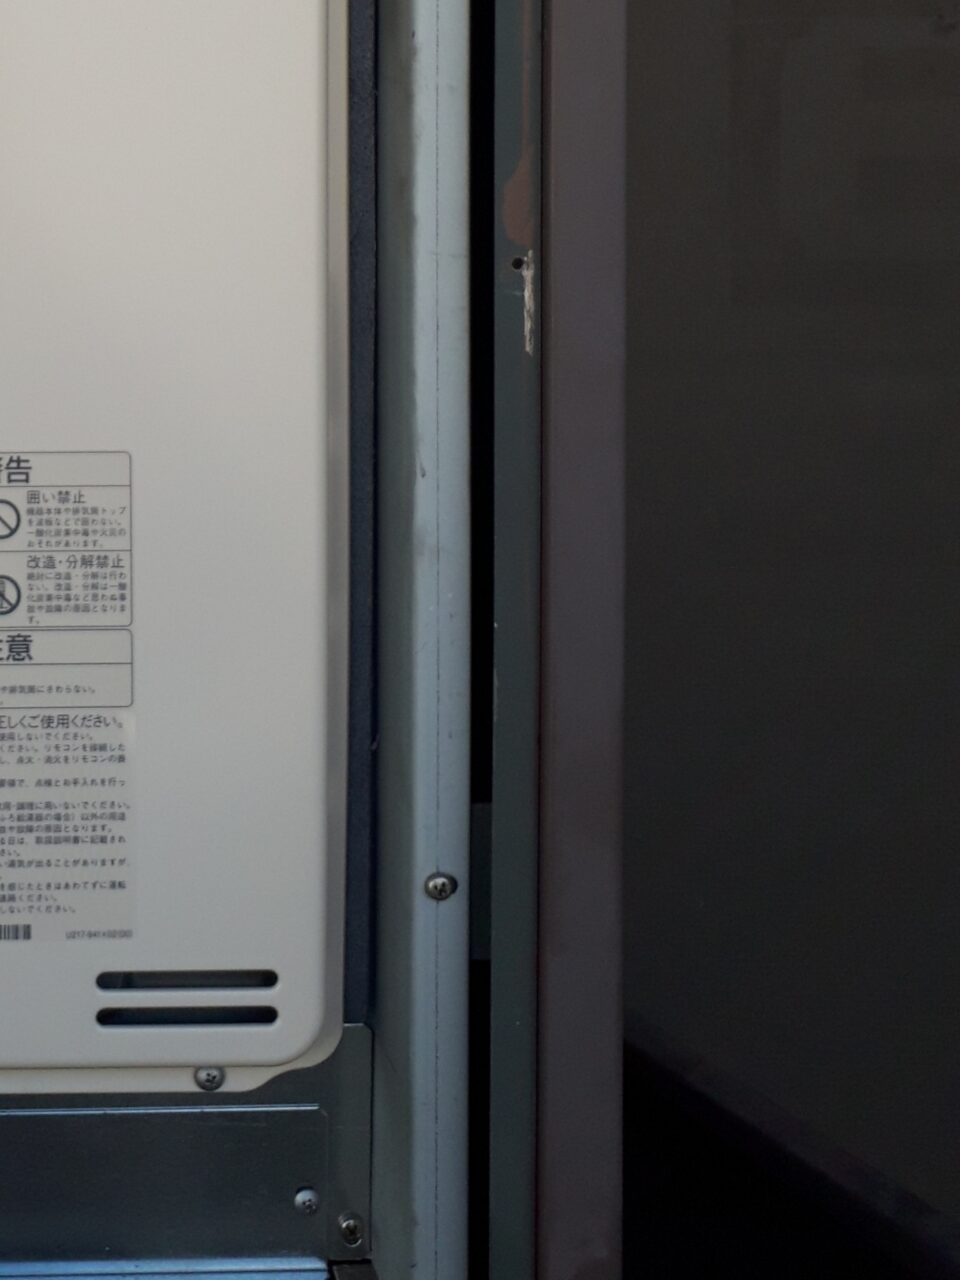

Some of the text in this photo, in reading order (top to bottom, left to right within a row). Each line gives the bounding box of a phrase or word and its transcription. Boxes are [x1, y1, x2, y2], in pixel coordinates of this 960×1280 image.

[27, 490, 86, 504] 囲い禁止
[27, 554, 125, 569] 改造・分解禁止
